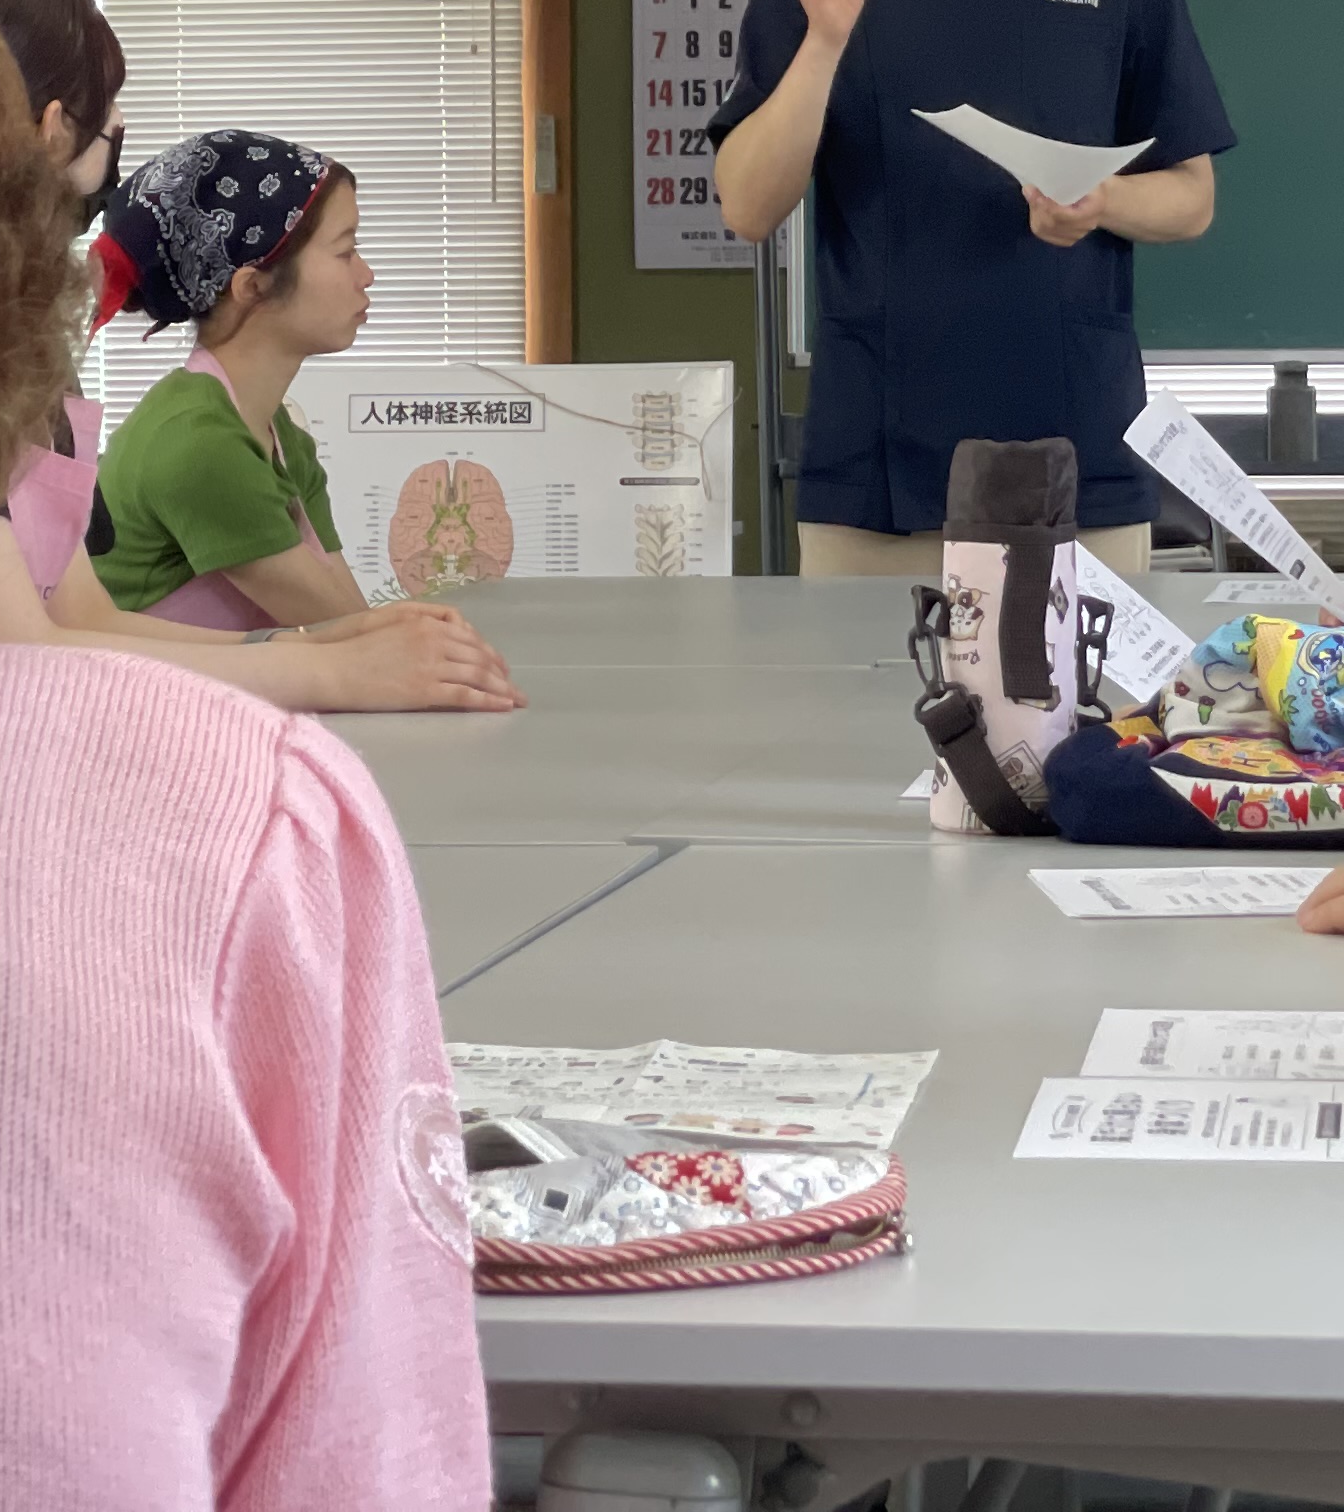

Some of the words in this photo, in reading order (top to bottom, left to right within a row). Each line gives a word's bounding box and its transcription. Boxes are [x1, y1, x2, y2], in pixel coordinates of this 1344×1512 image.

[652, 31, 668, 59] 7
[685, 30, 700, 59] 8
[718, 29, 733, 58] 9
[647, 79, 673, 107] 14
[680, 79, 707, 107] 15
[646, 128, 673, 156] 21
[679, 128, 708, 156] 22
[646, 177, 675, 205] 28
[679, 177, 708, 205] 29
[360, 400, 532, 426] 人体神経系統図
